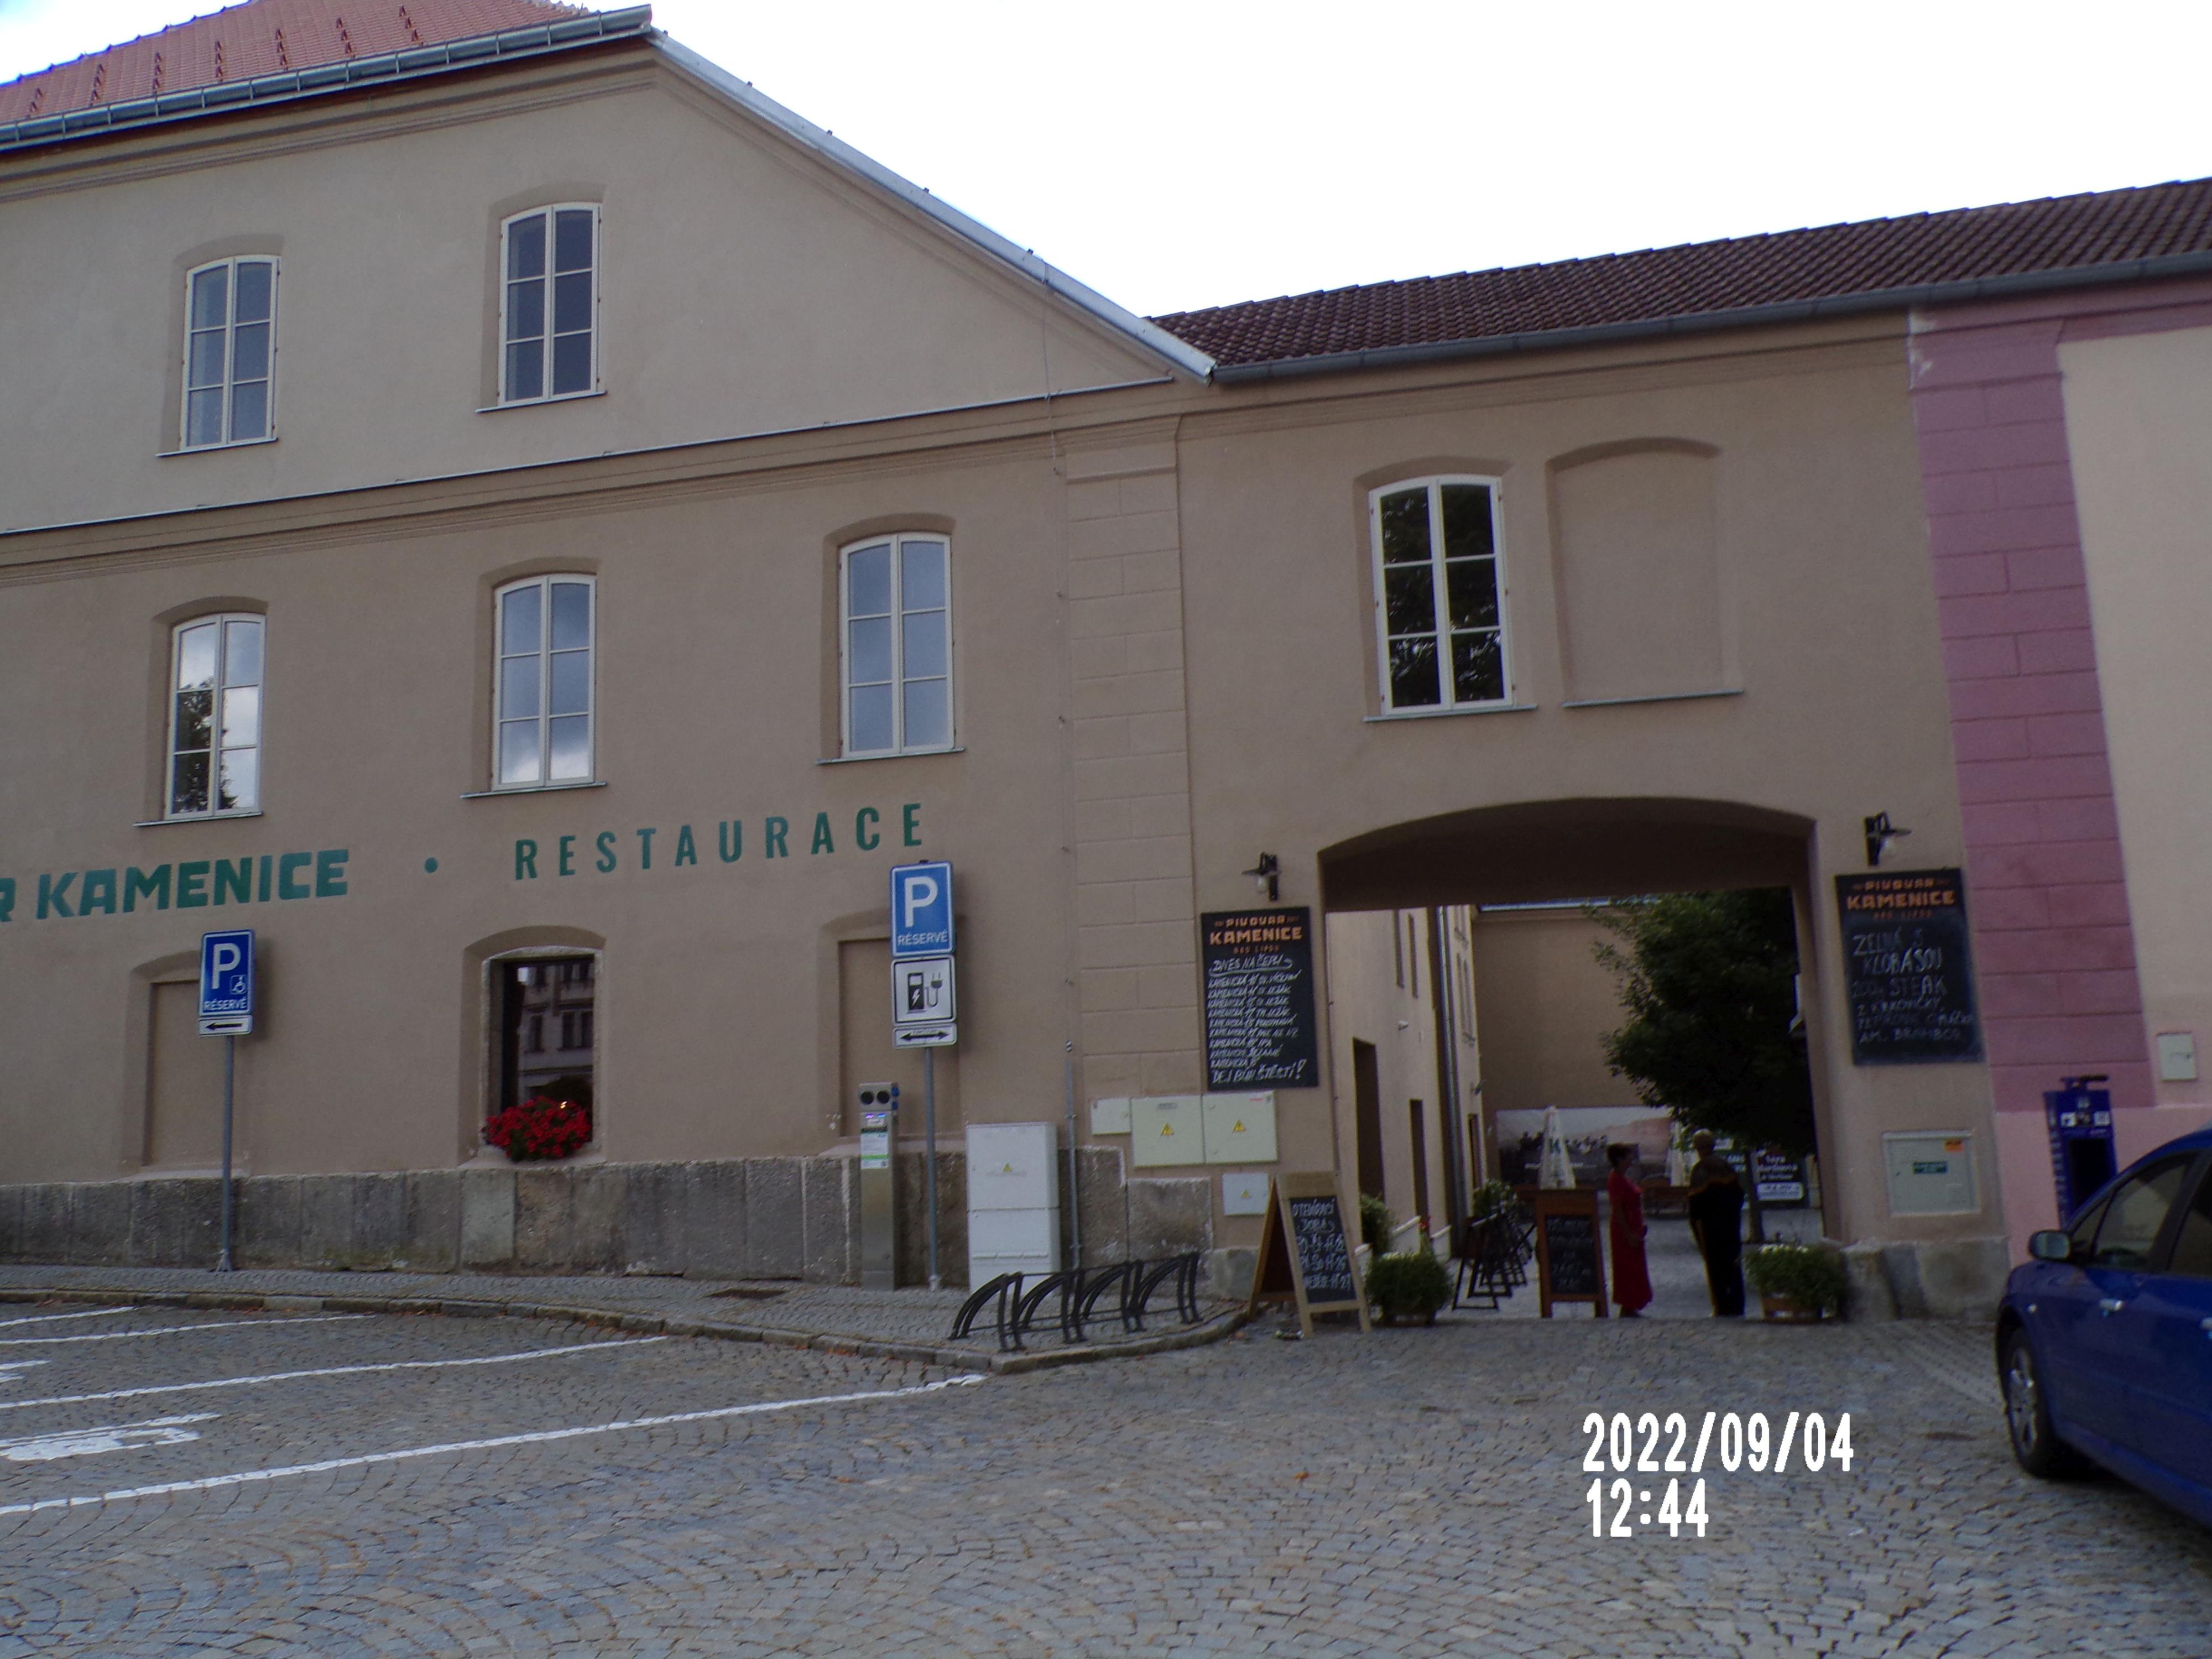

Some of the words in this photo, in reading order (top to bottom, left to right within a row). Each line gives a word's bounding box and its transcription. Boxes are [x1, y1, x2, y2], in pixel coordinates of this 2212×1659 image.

[514, 802, 922, 881] RESTAURACE
[36, 849, 349, 920] KAMENICE
[904, 875, 939, 928] P
[1847, 890, 1955, 910] KAMENICE
[1225, 914, 1286, 928] PIVOVAR
[896, 929, 949, 947] RÉSERVÉ
[1209, 926, 1303, 946] KAMENICE
[211, 942, 242, 989] P
[203, 995, 248, 1011] RÉSERVÉ
